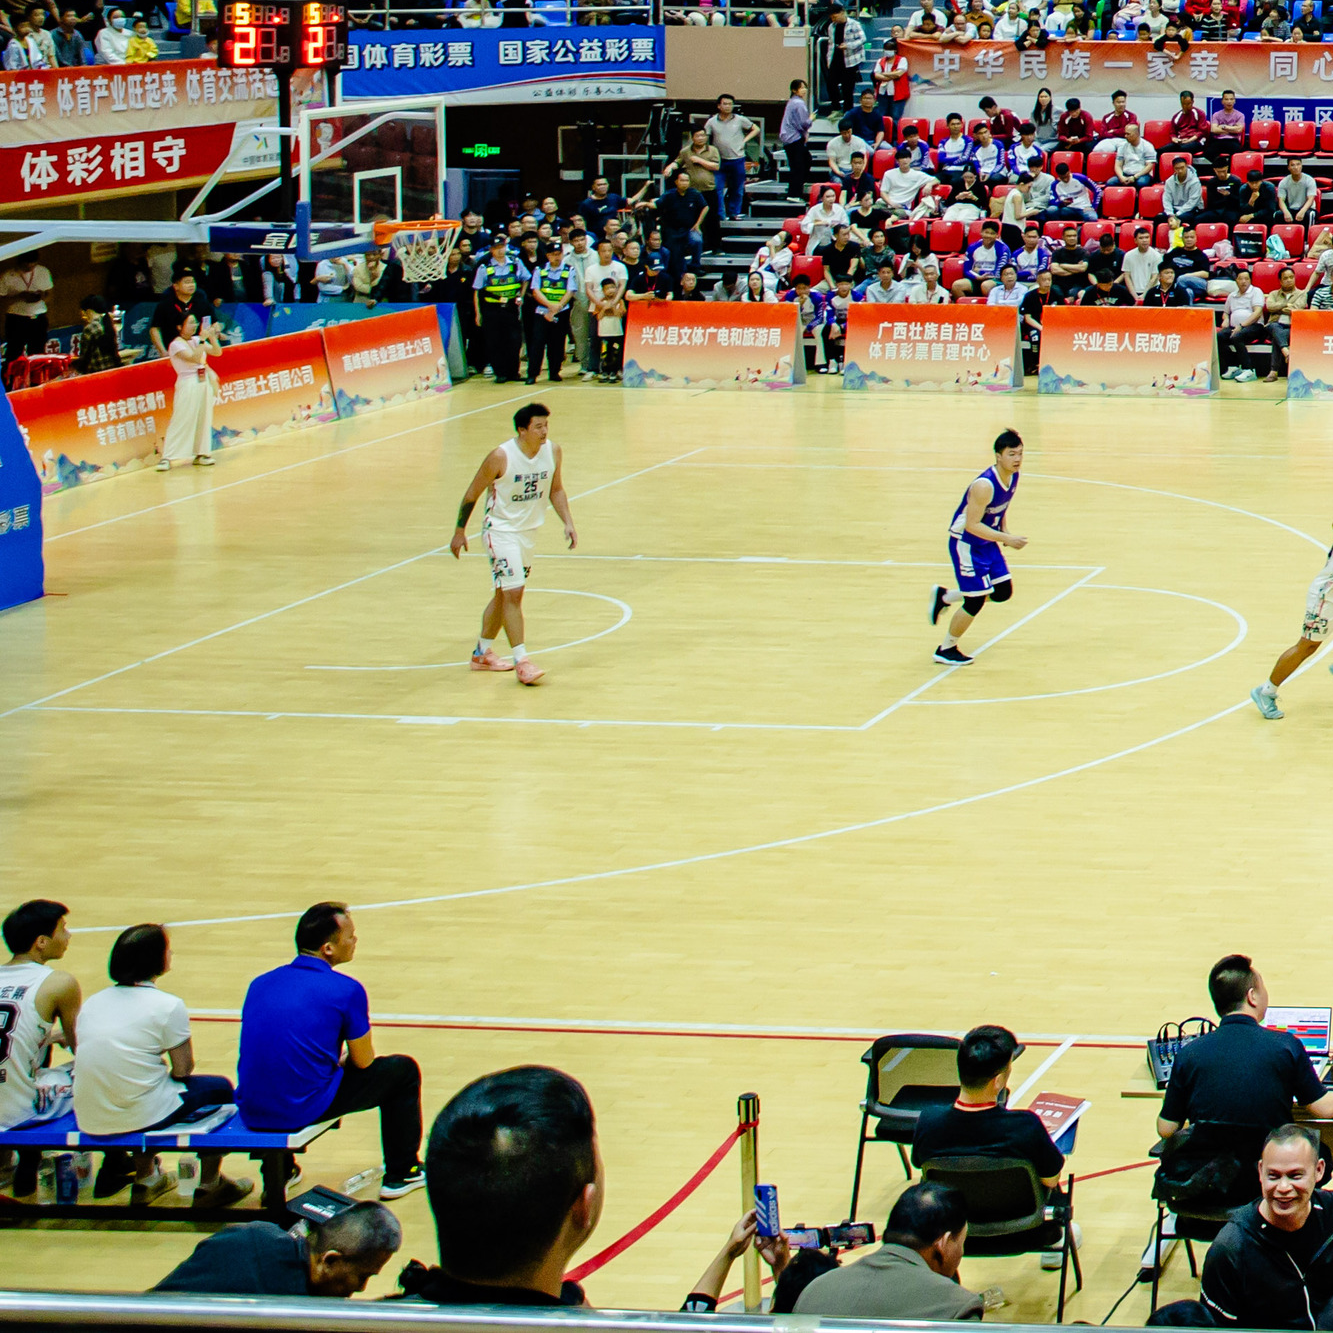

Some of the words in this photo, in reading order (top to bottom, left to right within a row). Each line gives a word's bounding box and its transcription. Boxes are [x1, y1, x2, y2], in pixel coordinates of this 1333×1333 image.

[233, 26, 256, 65] 2
[307, 25, 323, 65] 2
[499, 37, 655, 65] 国家公益彩票
[932, 49, 1221, 82] 中华民族一家亲
[57, 69, 177, 117] 体育产业旺起来
[21, 135, 187, 192] 体彩相守
[640, 325, 781, 349] 兴业县文体广电和旅游局
[876, 321, 985, 342] 广西壮族自治区
[1072, 332, 1181, 354] 兴业县人民政府
[868, 342, 991, 363] 体育彩票管理中心
[524, 481, 538, 493] 25
